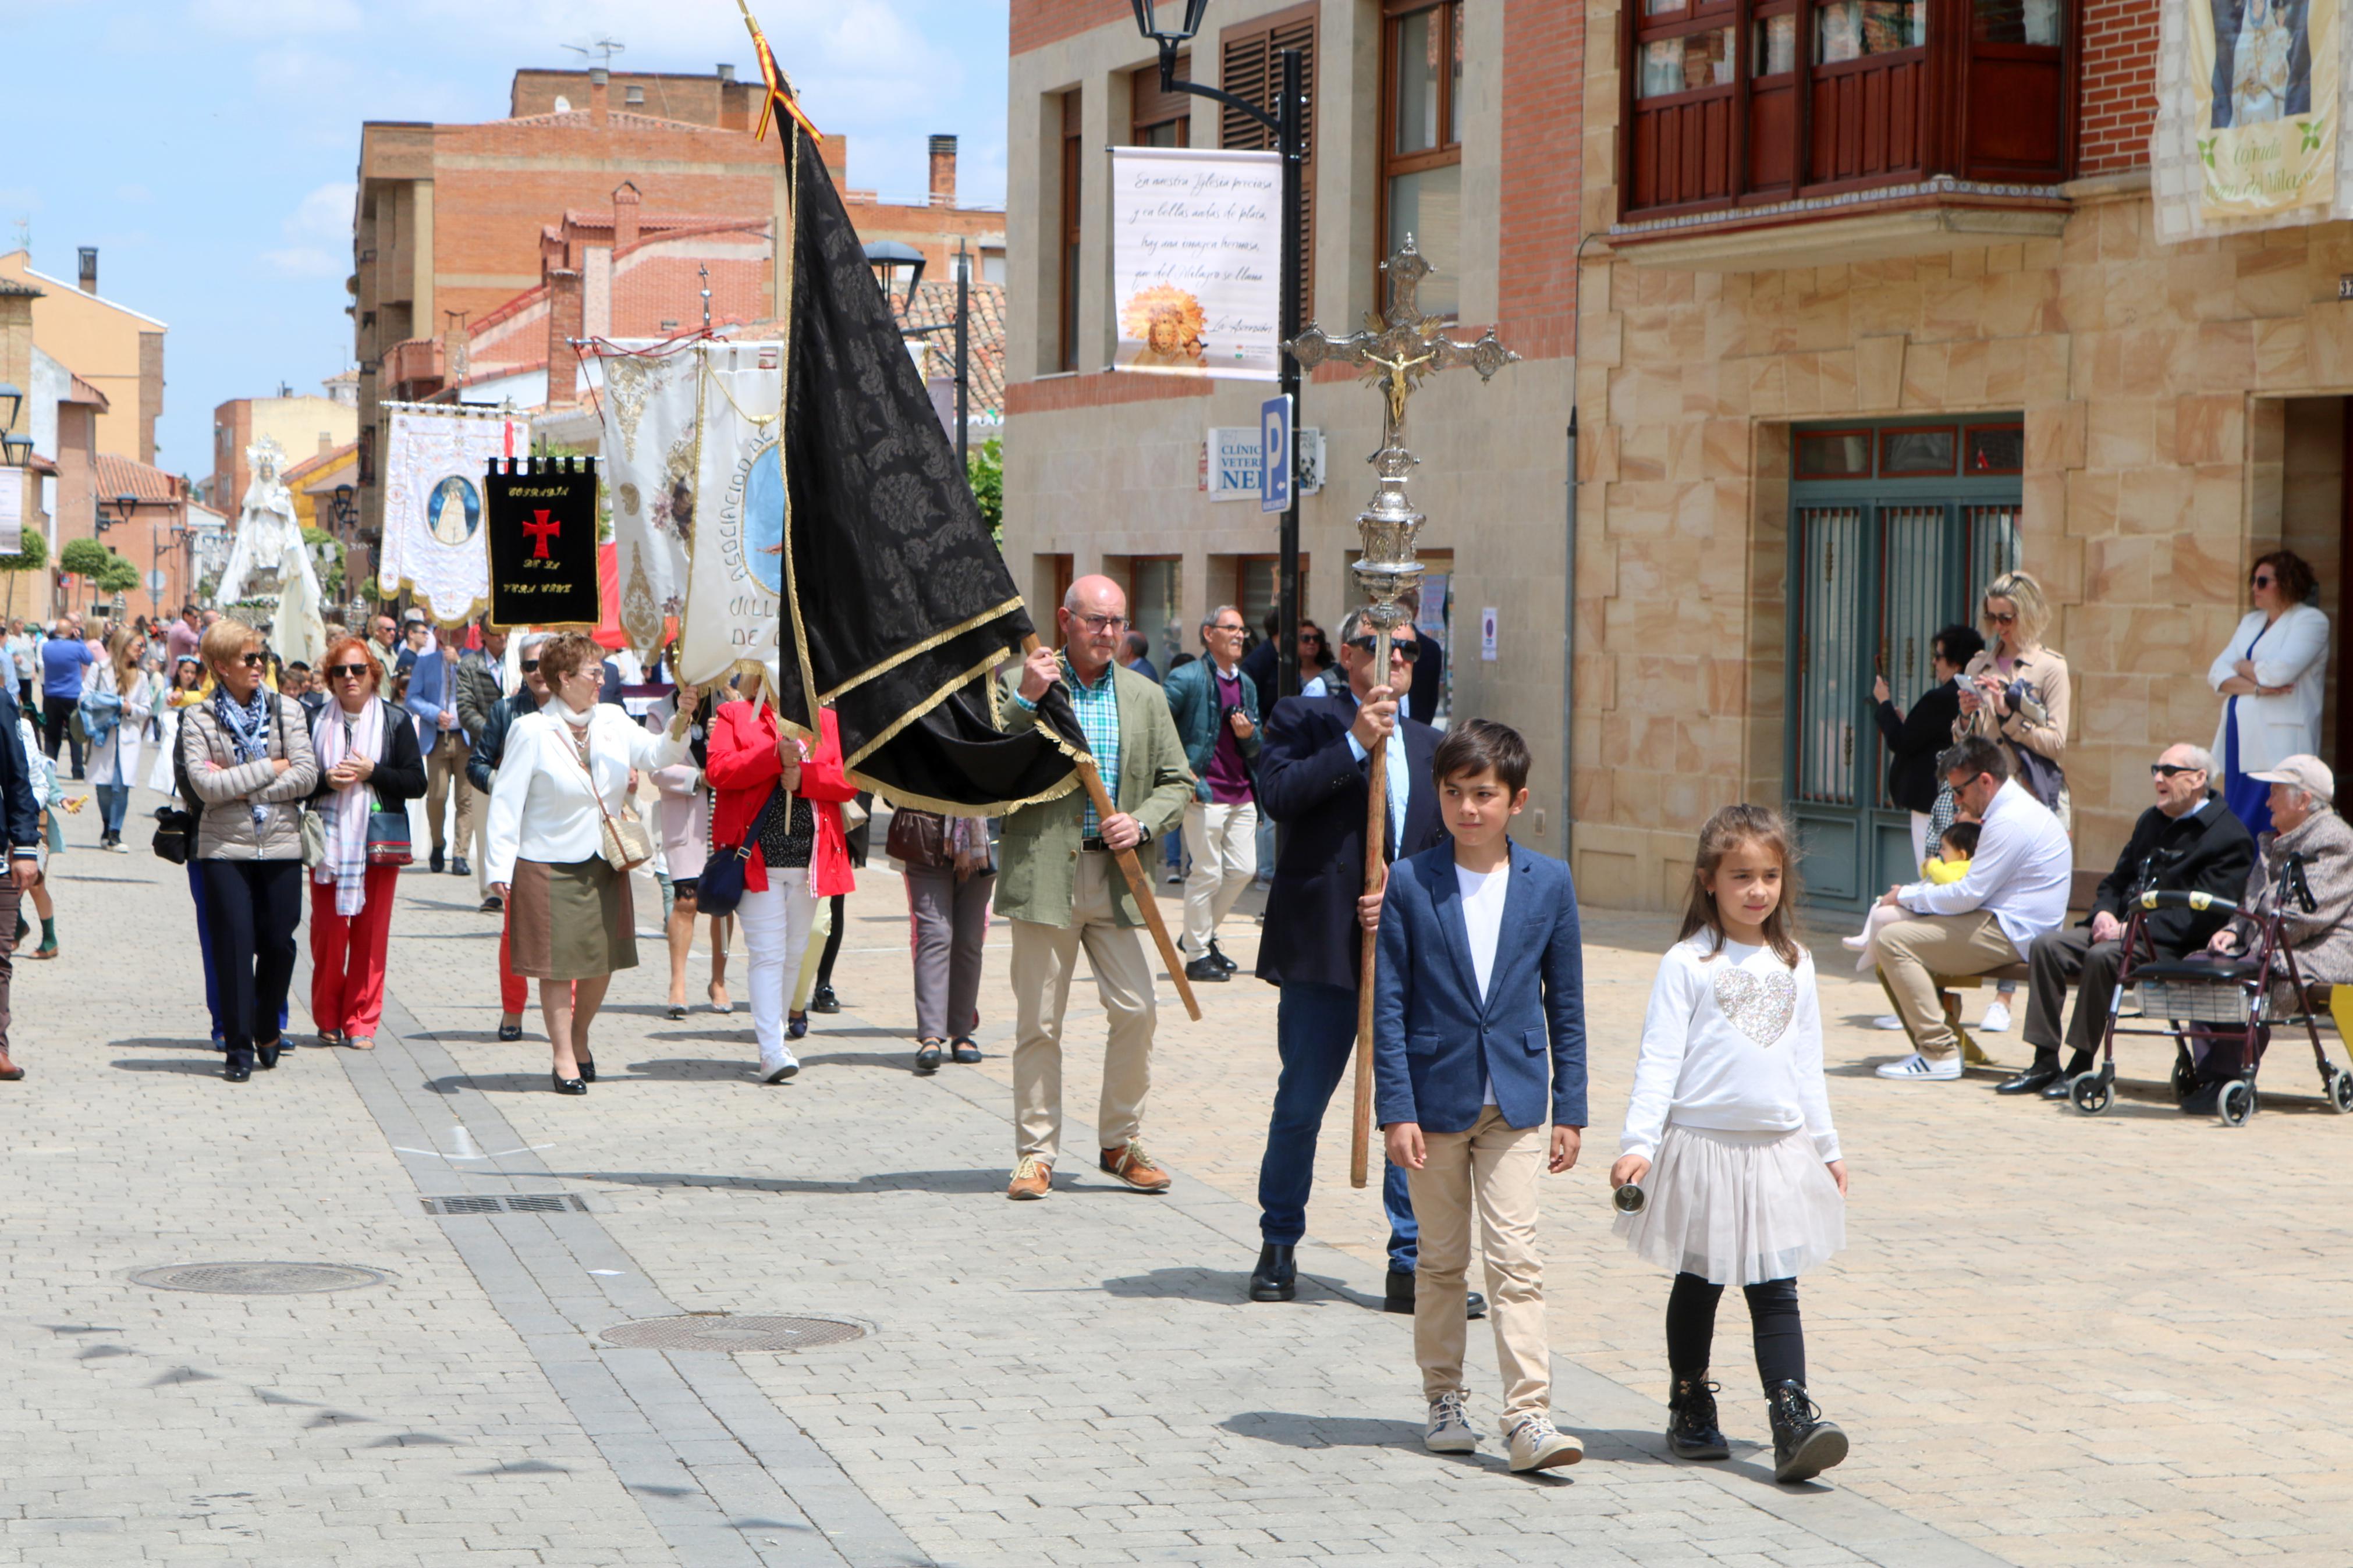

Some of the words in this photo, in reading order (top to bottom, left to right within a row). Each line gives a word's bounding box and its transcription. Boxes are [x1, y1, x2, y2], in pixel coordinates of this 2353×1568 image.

[1135, 172, 1149, 189] En
[1152, 175, 1188, 187] nuestra
[1190, 172, 1229, 196] Iglesia
[1231, 176, 1272, 190] preciosa
[1158, 201, 1188, 218] bellas
[1192, 202, 1220, 219] andas
[1223, 203, 1235, 219] de
[1141, 233, 1158, 256] hay
[1161, 239, 1178, 248] una
[1182, 236, 1218, 258] imagen
[1154, 262, 1177, 279] del
[1176, 264, 1220, 288] Milagro
[1222, 272, 1233, 280] se
[1236, 265, 1263, 281] llama
[749, 426, 773, 453] DE
[1221, 443, 1262, 454] CLÍNIC
[1266, 411, 1283, 499] P
[732, 628, 758, 646] DE
